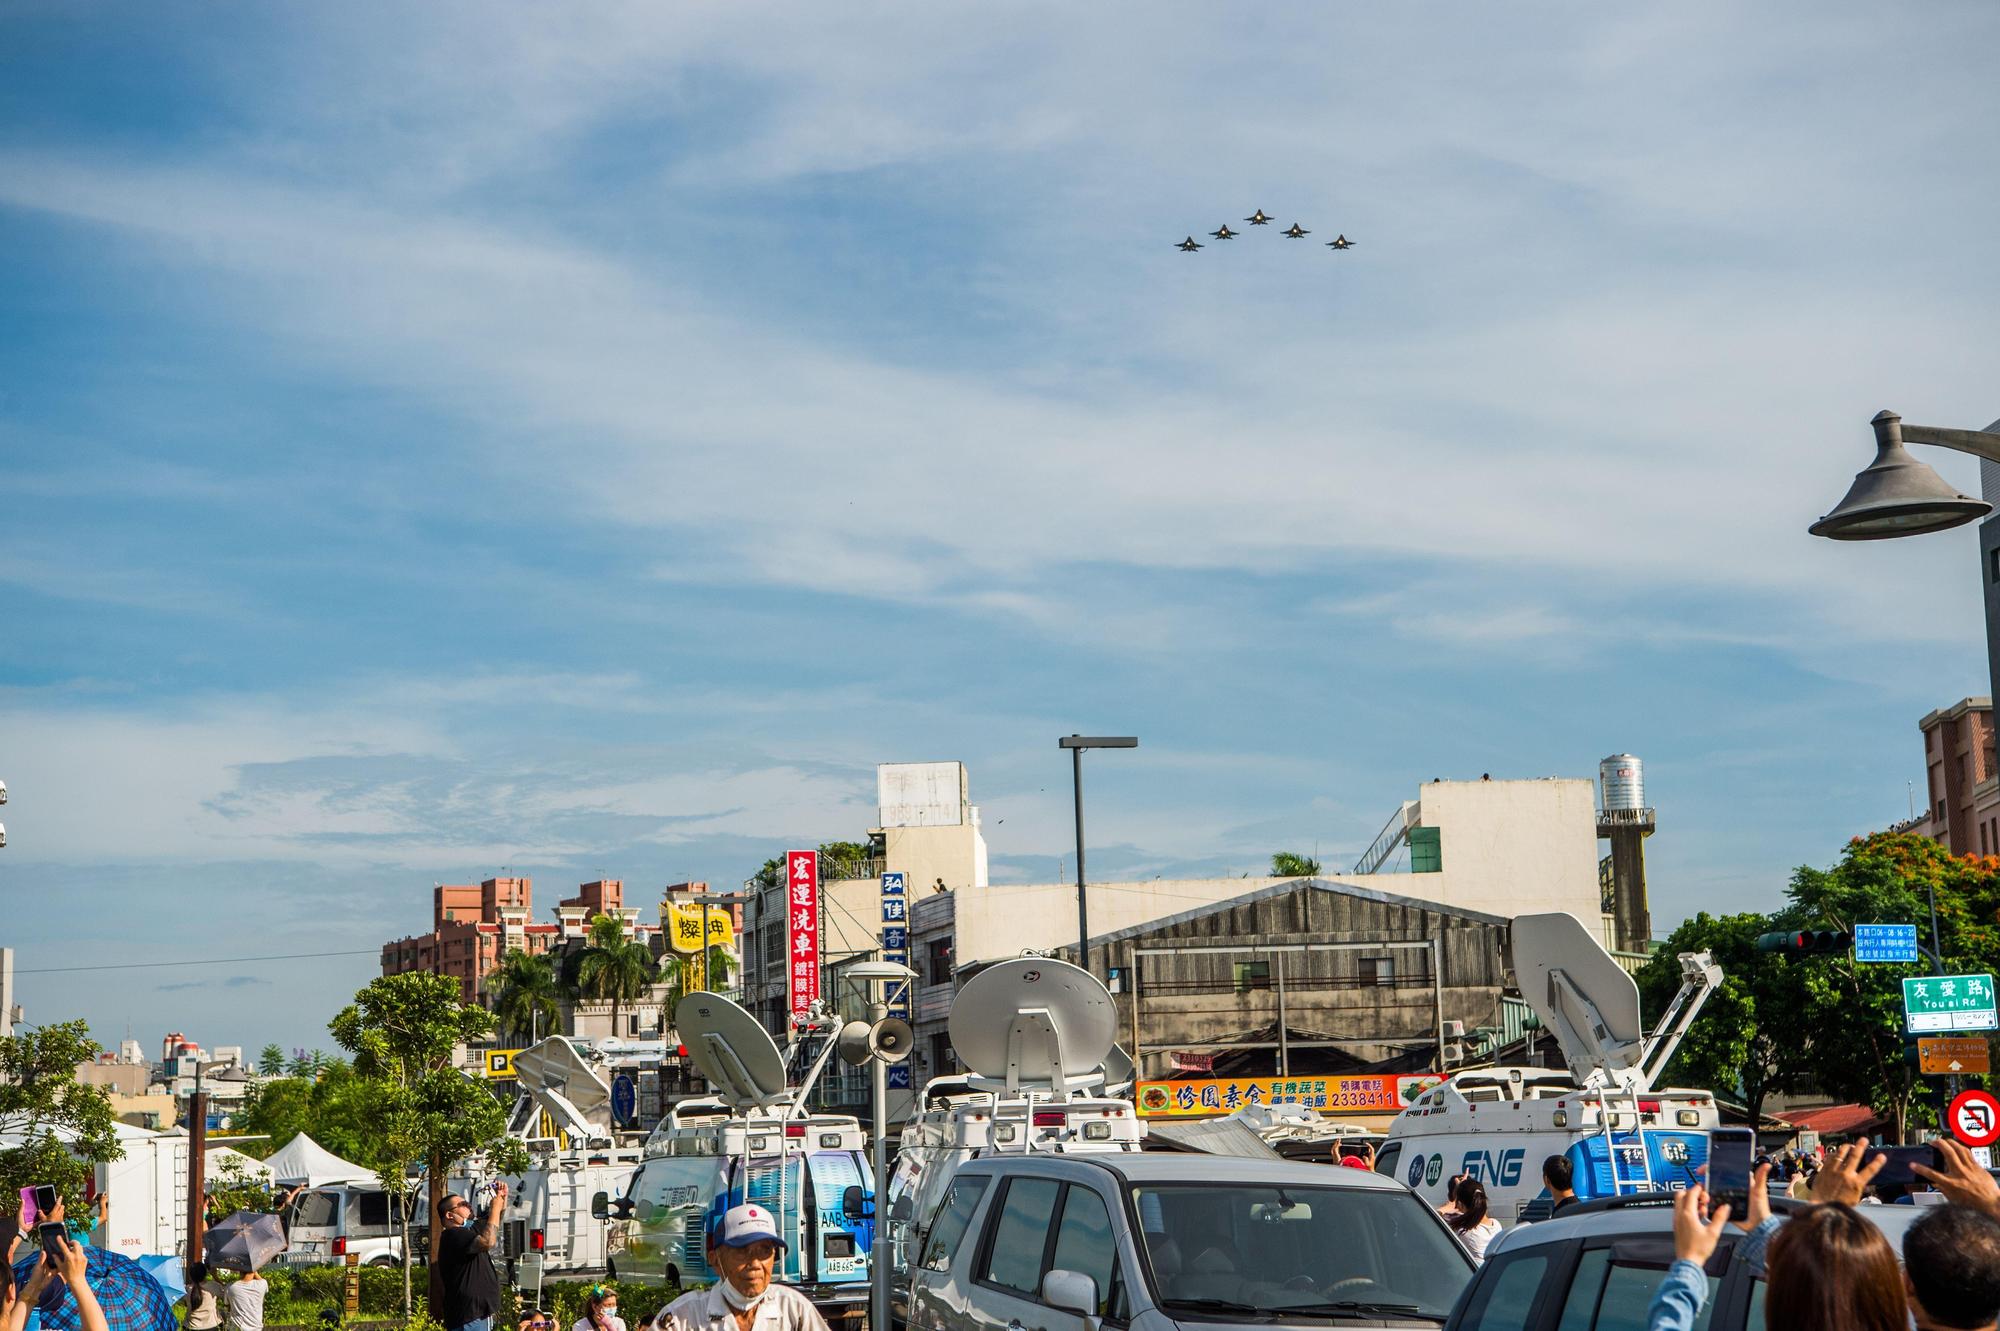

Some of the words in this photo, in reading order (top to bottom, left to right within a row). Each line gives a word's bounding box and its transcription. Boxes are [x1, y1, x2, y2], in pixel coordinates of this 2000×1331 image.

[792, 856, 815, 958] 宏運洗車
[678, 917, 724, 939] 燦坤
[1913, 979, 1984, 998] 友愛路
[1962, 998, 1980, 1007] Rd.
[493, 1056, 506, 1070] P
[1271, 1081, 1327, 1095] 有機蔬菜
[1340, 1080, 1383, 1092] 預購電話
[1176, 1083, 1266, 1110] 修圓素食
[1331, 1092, 1394, 1107] 2338411
[1427, 1159, 1442, 1180] CTS
[1461, 1149, 1526, 1187] SNG
